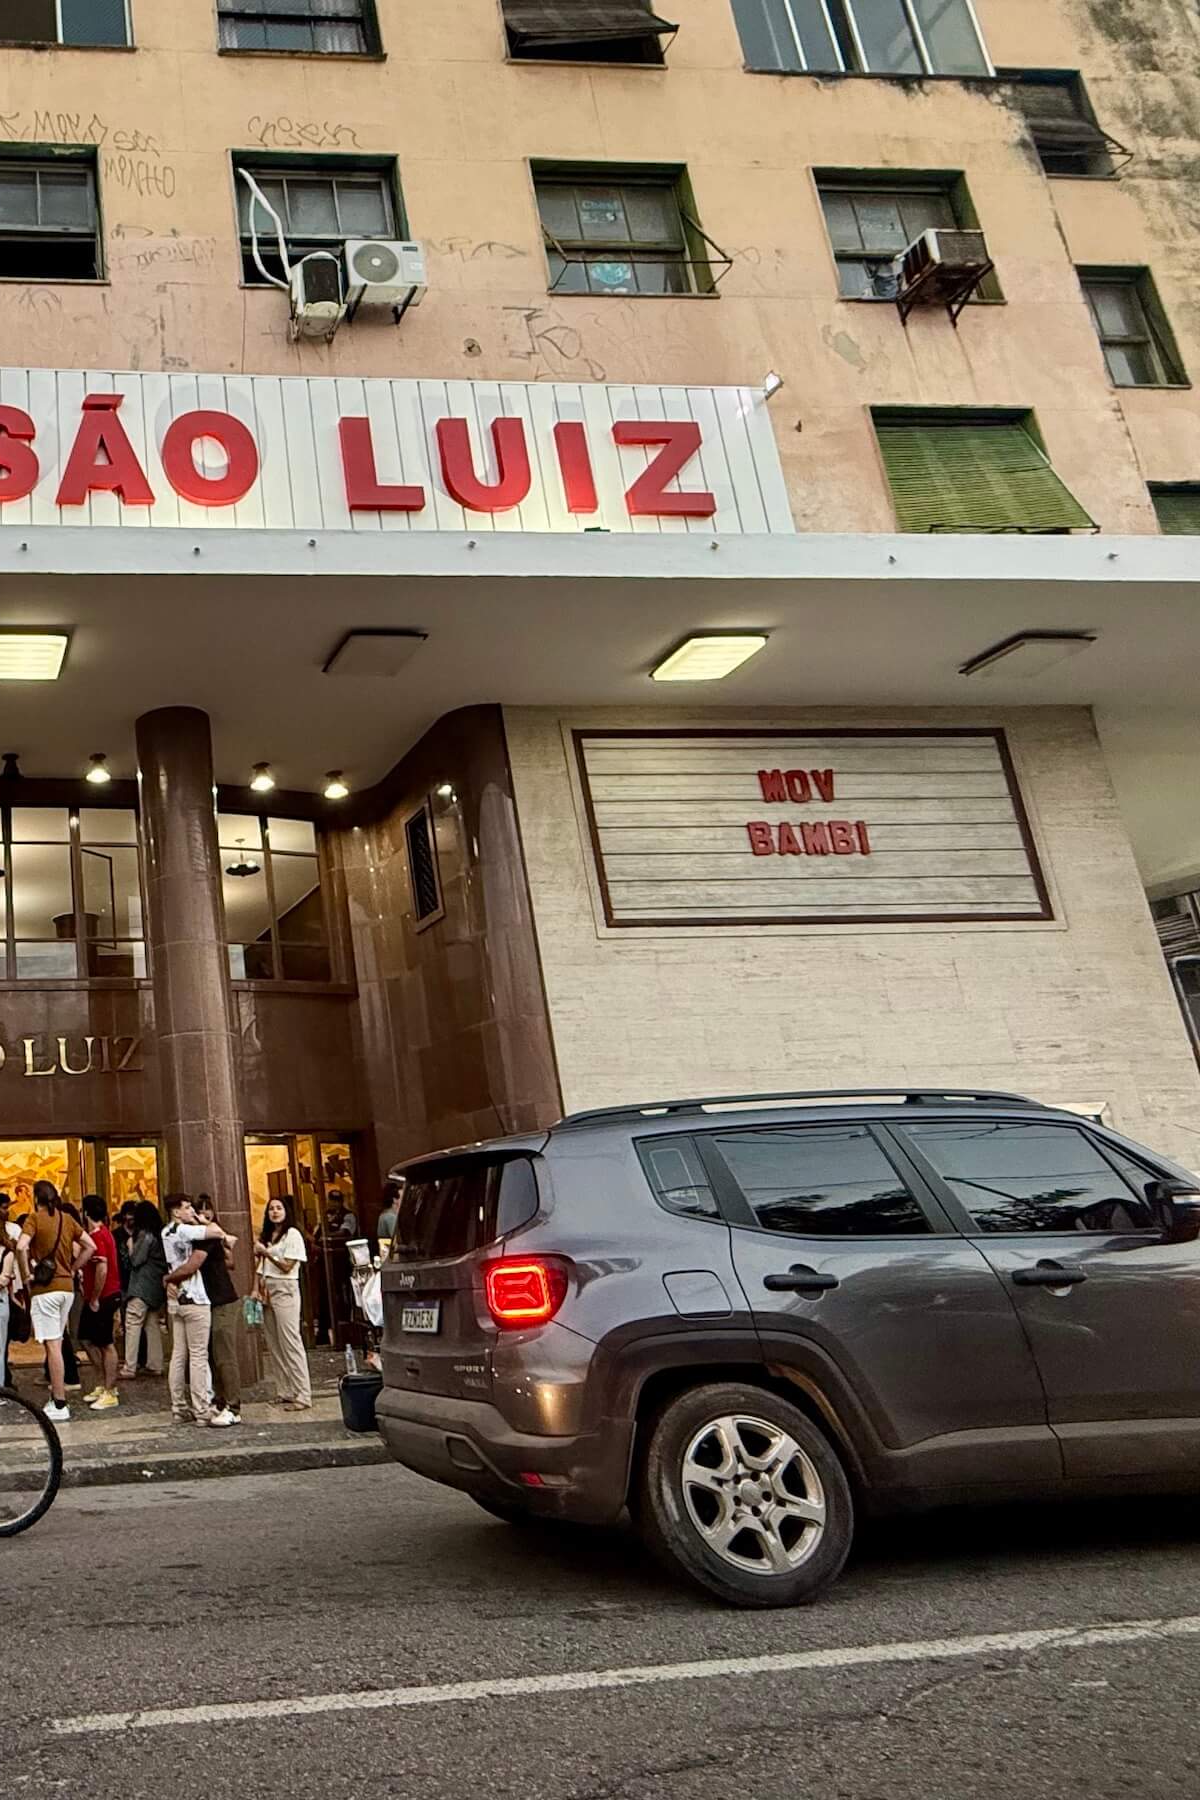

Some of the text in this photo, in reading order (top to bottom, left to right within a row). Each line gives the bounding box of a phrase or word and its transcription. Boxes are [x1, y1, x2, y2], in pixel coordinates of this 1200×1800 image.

[337, 416, 716, 518] LUIZ
[756, 768, 836, 804] MOV
[745, 820, 872, 857] BAMBI
[23, 1035, 145, 1077] LUIZ
